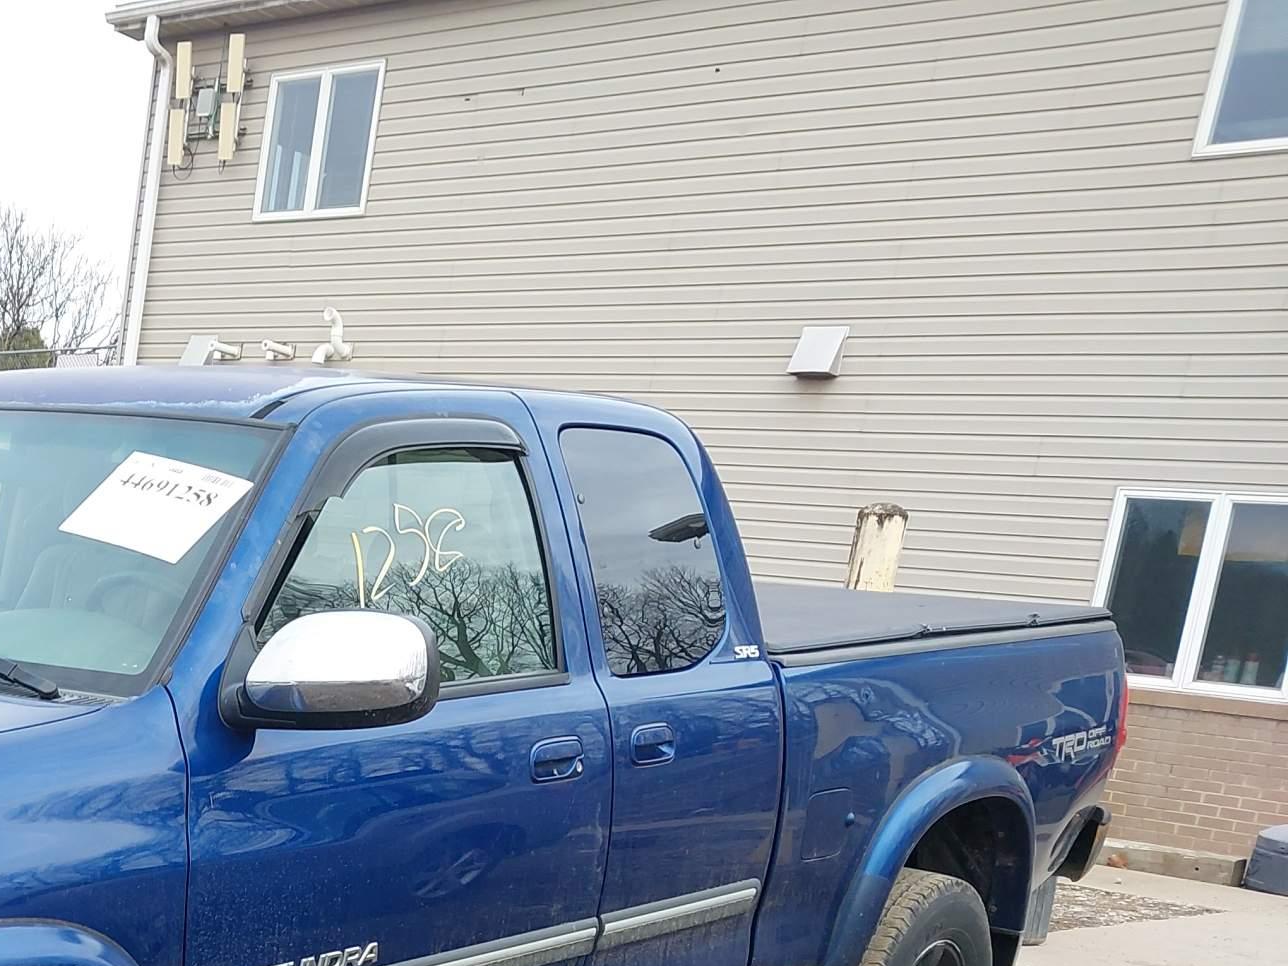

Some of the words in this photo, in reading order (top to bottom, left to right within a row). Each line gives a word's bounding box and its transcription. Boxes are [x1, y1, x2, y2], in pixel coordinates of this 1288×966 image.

[119, 473, 218, 506] 44691258
[734, 644, 760, 659] SR5
[1052, 731, 1087, 761] TRD
[1088, 724, 1107, 738] OFF
[1087, 736, 1111, 749] ROAD
